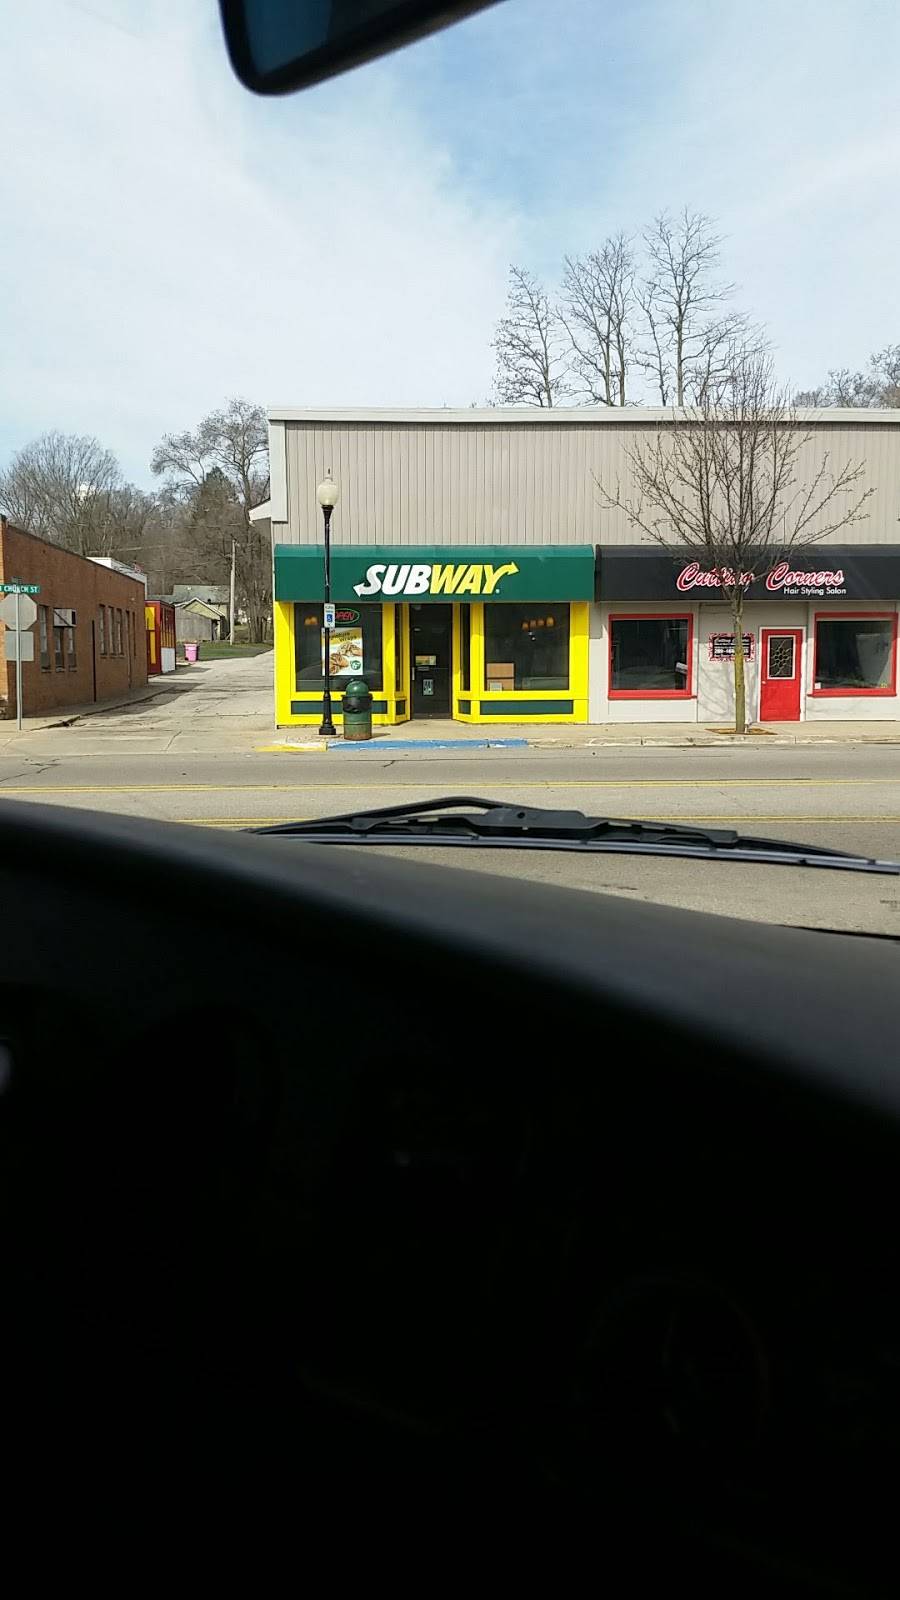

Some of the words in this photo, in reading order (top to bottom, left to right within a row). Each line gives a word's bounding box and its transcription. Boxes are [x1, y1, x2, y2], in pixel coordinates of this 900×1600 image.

[353, 562, 519, 597] SUBWAY
[765, 562, 844, 590] Corners
[783, 586, 799, 594] Hair
[800, 586, 824, 596] Styling
[826, 586, 847, 595] Salon
